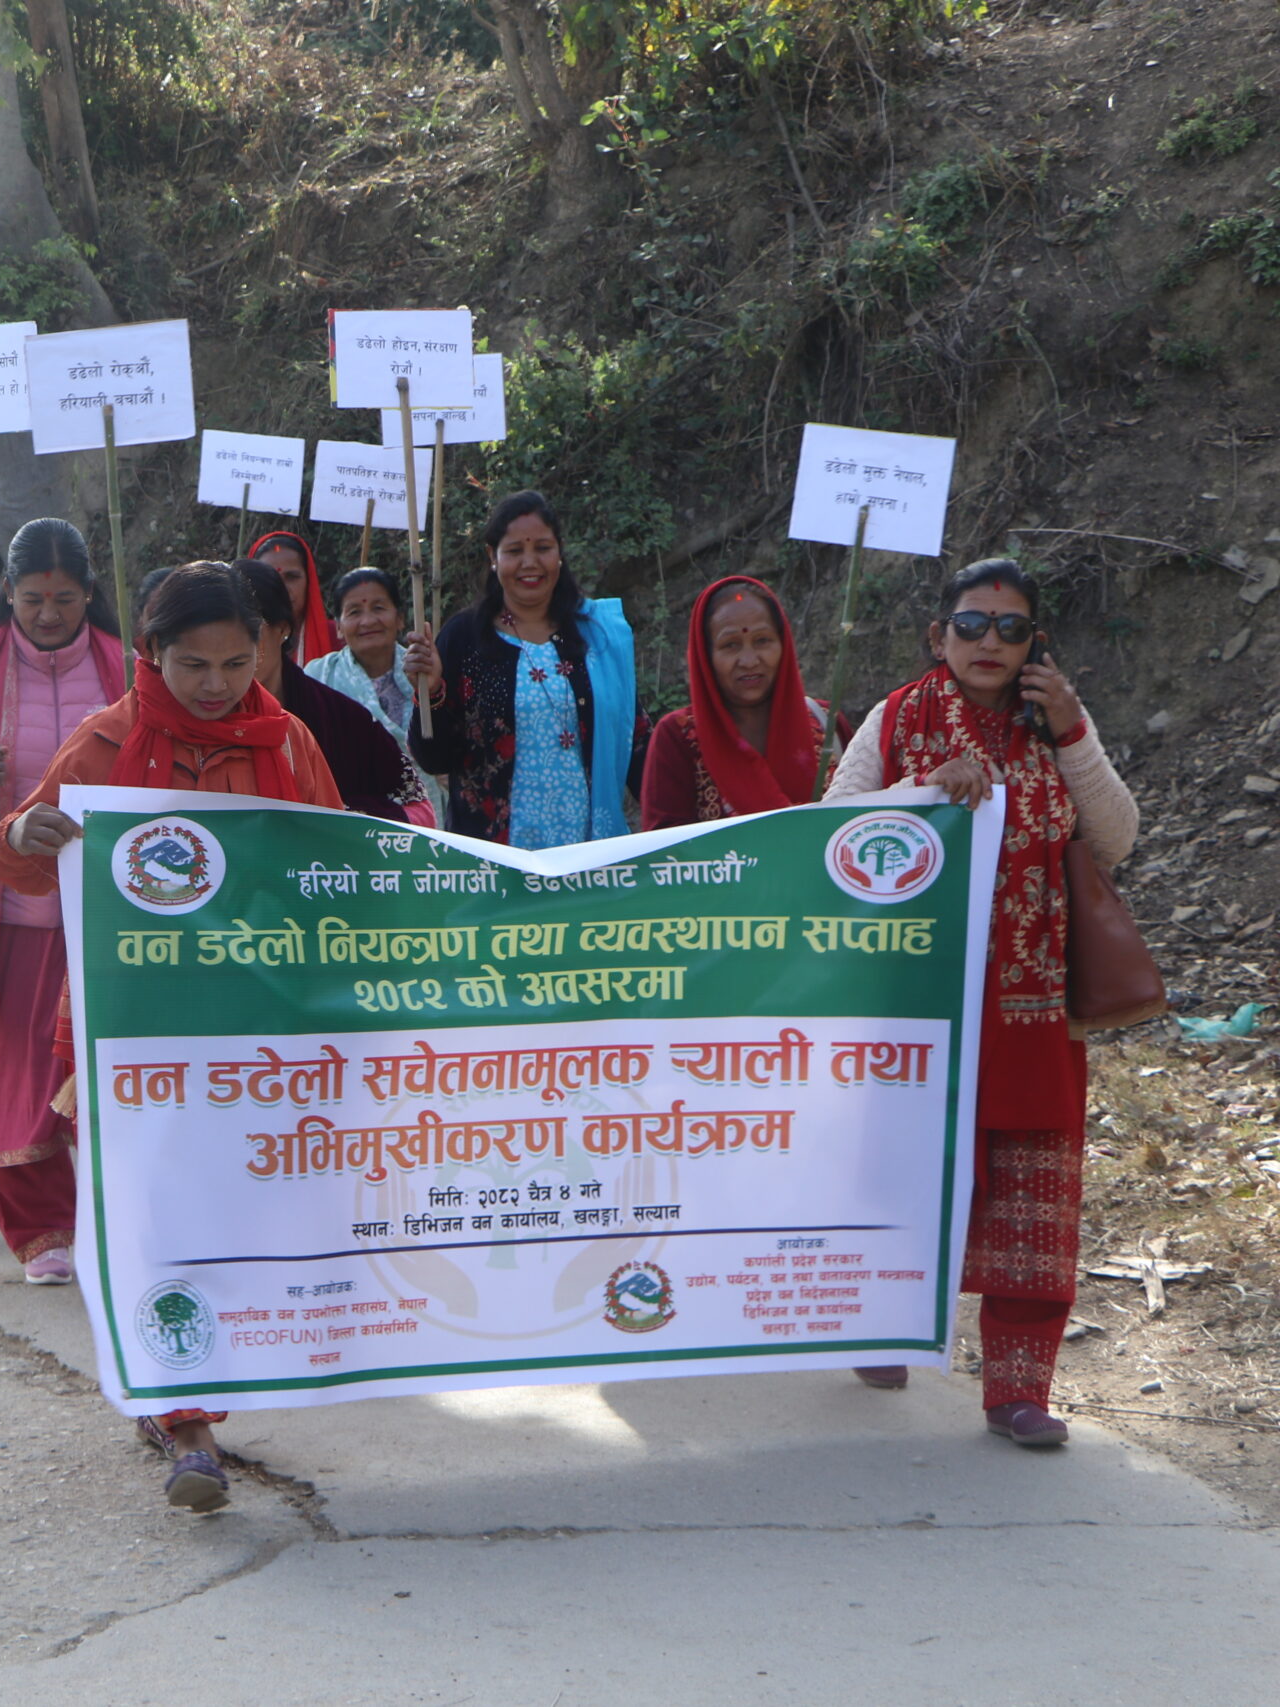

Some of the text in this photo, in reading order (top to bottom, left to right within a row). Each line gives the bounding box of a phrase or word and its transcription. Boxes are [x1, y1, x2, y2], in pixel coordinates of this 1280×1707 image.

[287, 861, 359, 899] “हरियो
[369, 870, 402, 893] वन
[118, 915, 938, 967] वन डढेलो नियन्त्रण तथा व्यवस्थापन सप्ताह
[354, 964, 688, 1012] २०८२ को अवसरमा
[112, 1062, 190, 1106] वन
[207, 1044, 349, 1105] डढेलो
[362, 1040, 655, 1102] सचेतनामूलक
[829, 1041, 934, 1084] तथा
[245, 1099, 796, 1182] अभिमुखीकरण कार्यक्रम
[478, 1188, 520, 1209] २०८२
[527, 1181, 552, 1201] चैत्र
[559, 1184, 570, 1201] ४
[580, 1179, 602, 1199] गते
[403, 1215, 465, 1236] डिभिजन
[471, 1214, 494, 1230] वन
[500, 1207, 565, 1229] कार्यालय,
[632, 1204, 682, 1222] सल्यान
[744, 1253, 864, 1268] कर्णाली प्रदेश सरकार
[771, 1273, 786, 1283] वन
[793, 1272, 813, 1282] तथा
[277, 1308, 295, 1321] वन
[397, 1296, 428, 1311] नेपाल
[230, 1326, 322, 1350] (FECOFUN)
